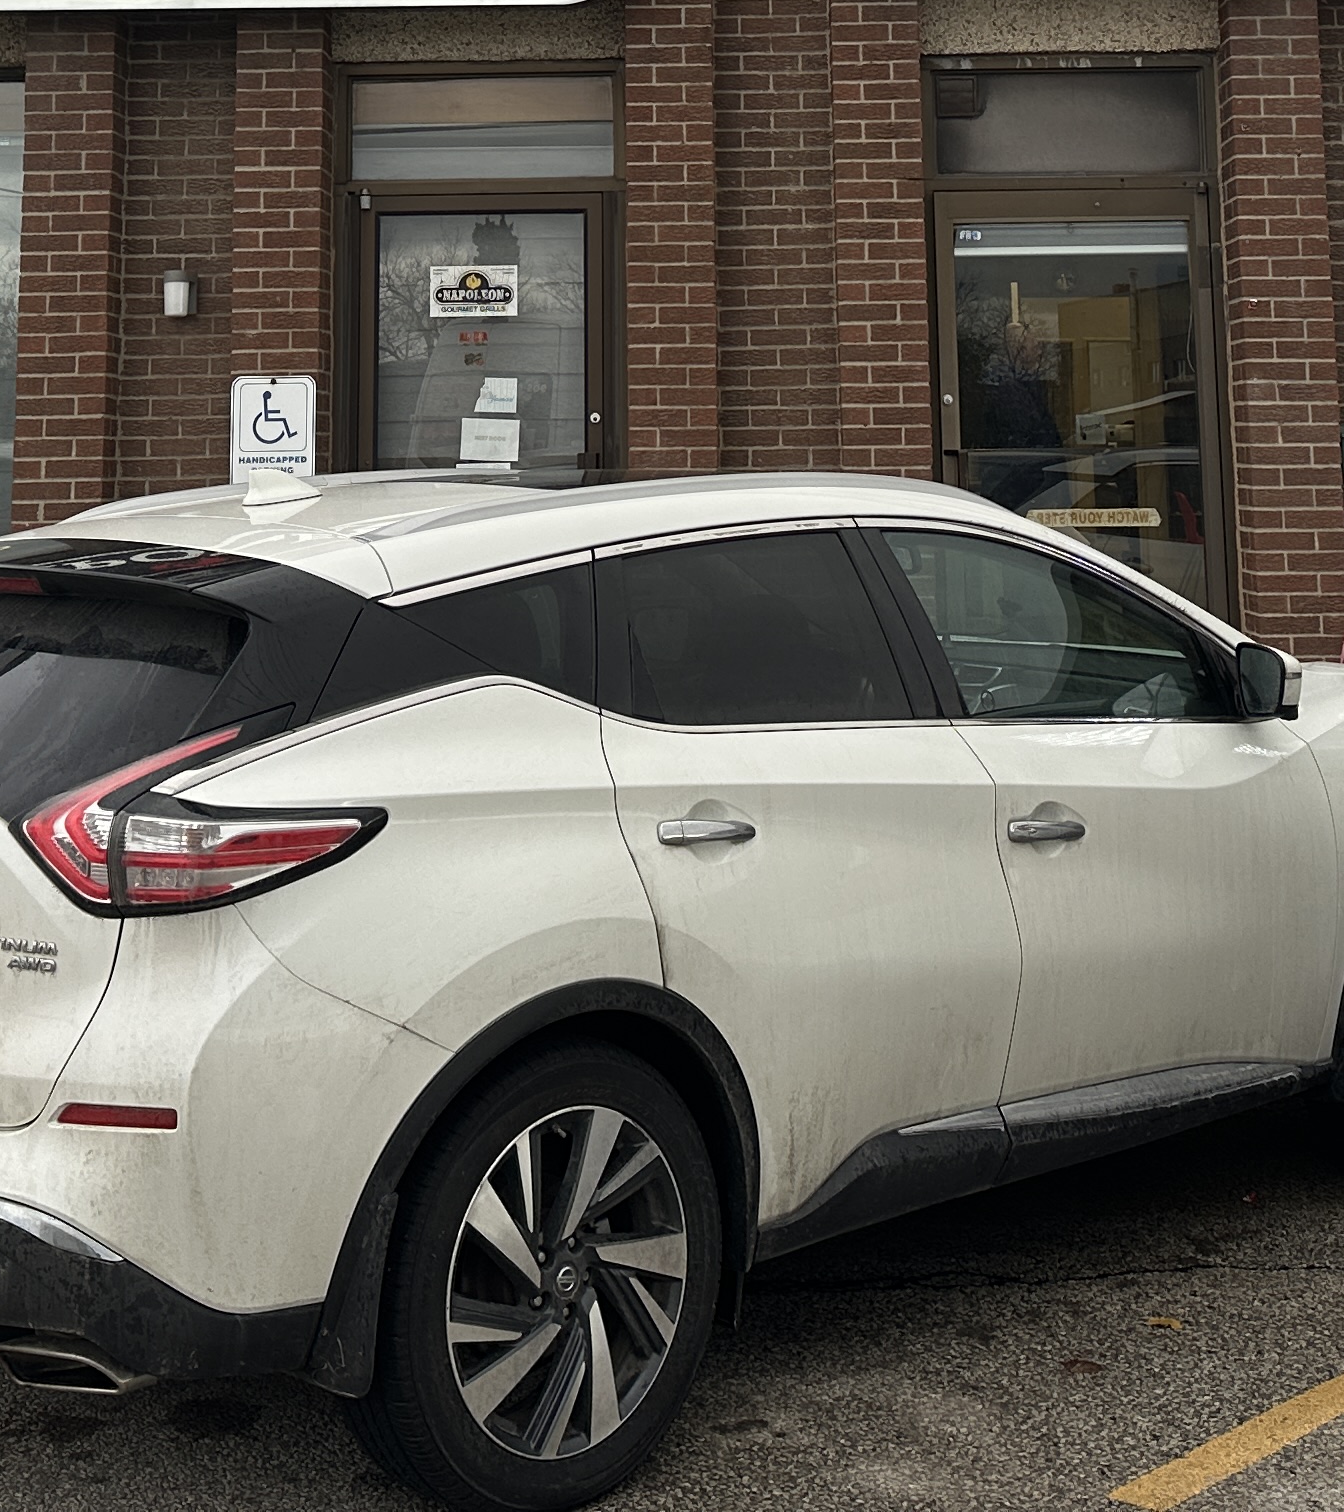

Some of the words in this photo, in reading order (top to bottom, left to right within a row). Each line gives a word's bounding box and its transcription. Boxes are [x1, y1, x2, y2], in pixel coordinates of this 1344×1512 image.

[442, 289, 505, 301] NAPOLEON
[238, 455, 308, 464] HANDICAPPED
[7, 955, 57, 973] AWD
